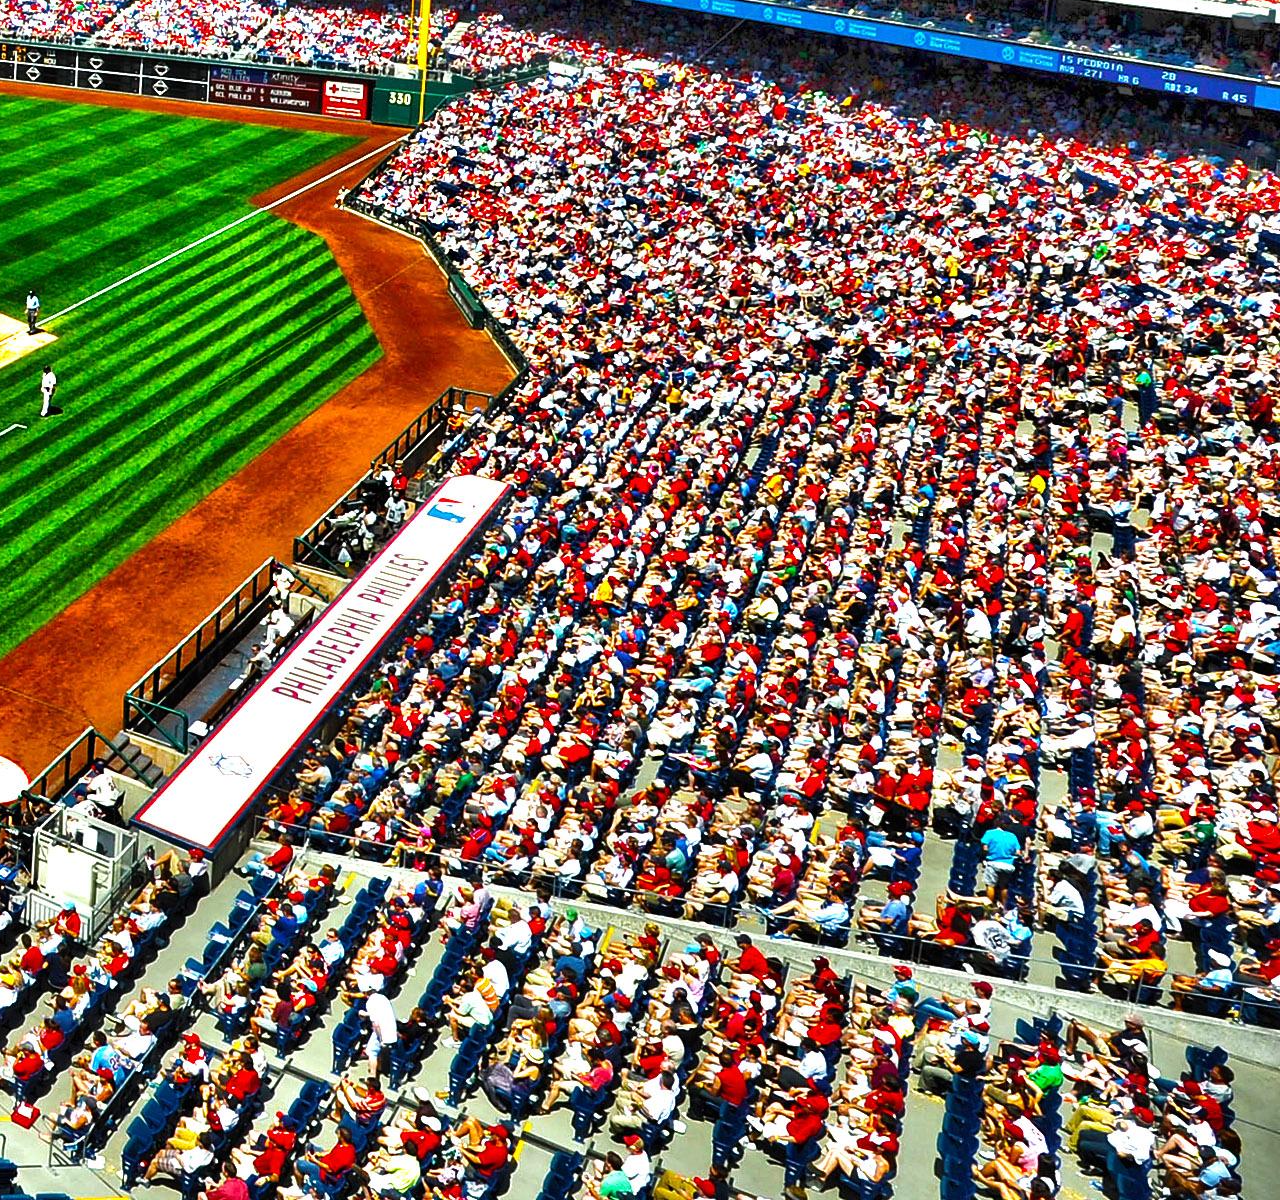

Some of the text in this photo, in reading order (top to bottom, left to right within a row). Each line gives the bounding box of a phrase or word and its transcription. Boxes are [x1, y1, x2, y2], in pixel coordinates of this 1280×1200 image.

[1061, 55, 1124, 72] 15 PEDROIA
[271, 72, 301, 83] xfinity
[388, 91, 412, 105] 330
[1164, 82, 1181, 92] RBI
[1184, 86, 1198, 95] 34
[1231, 93, 1248, 103] 45
[357, 553, 429, 607] PHILLIES
[271, 607, 386, 704] PHILADELPHIA
